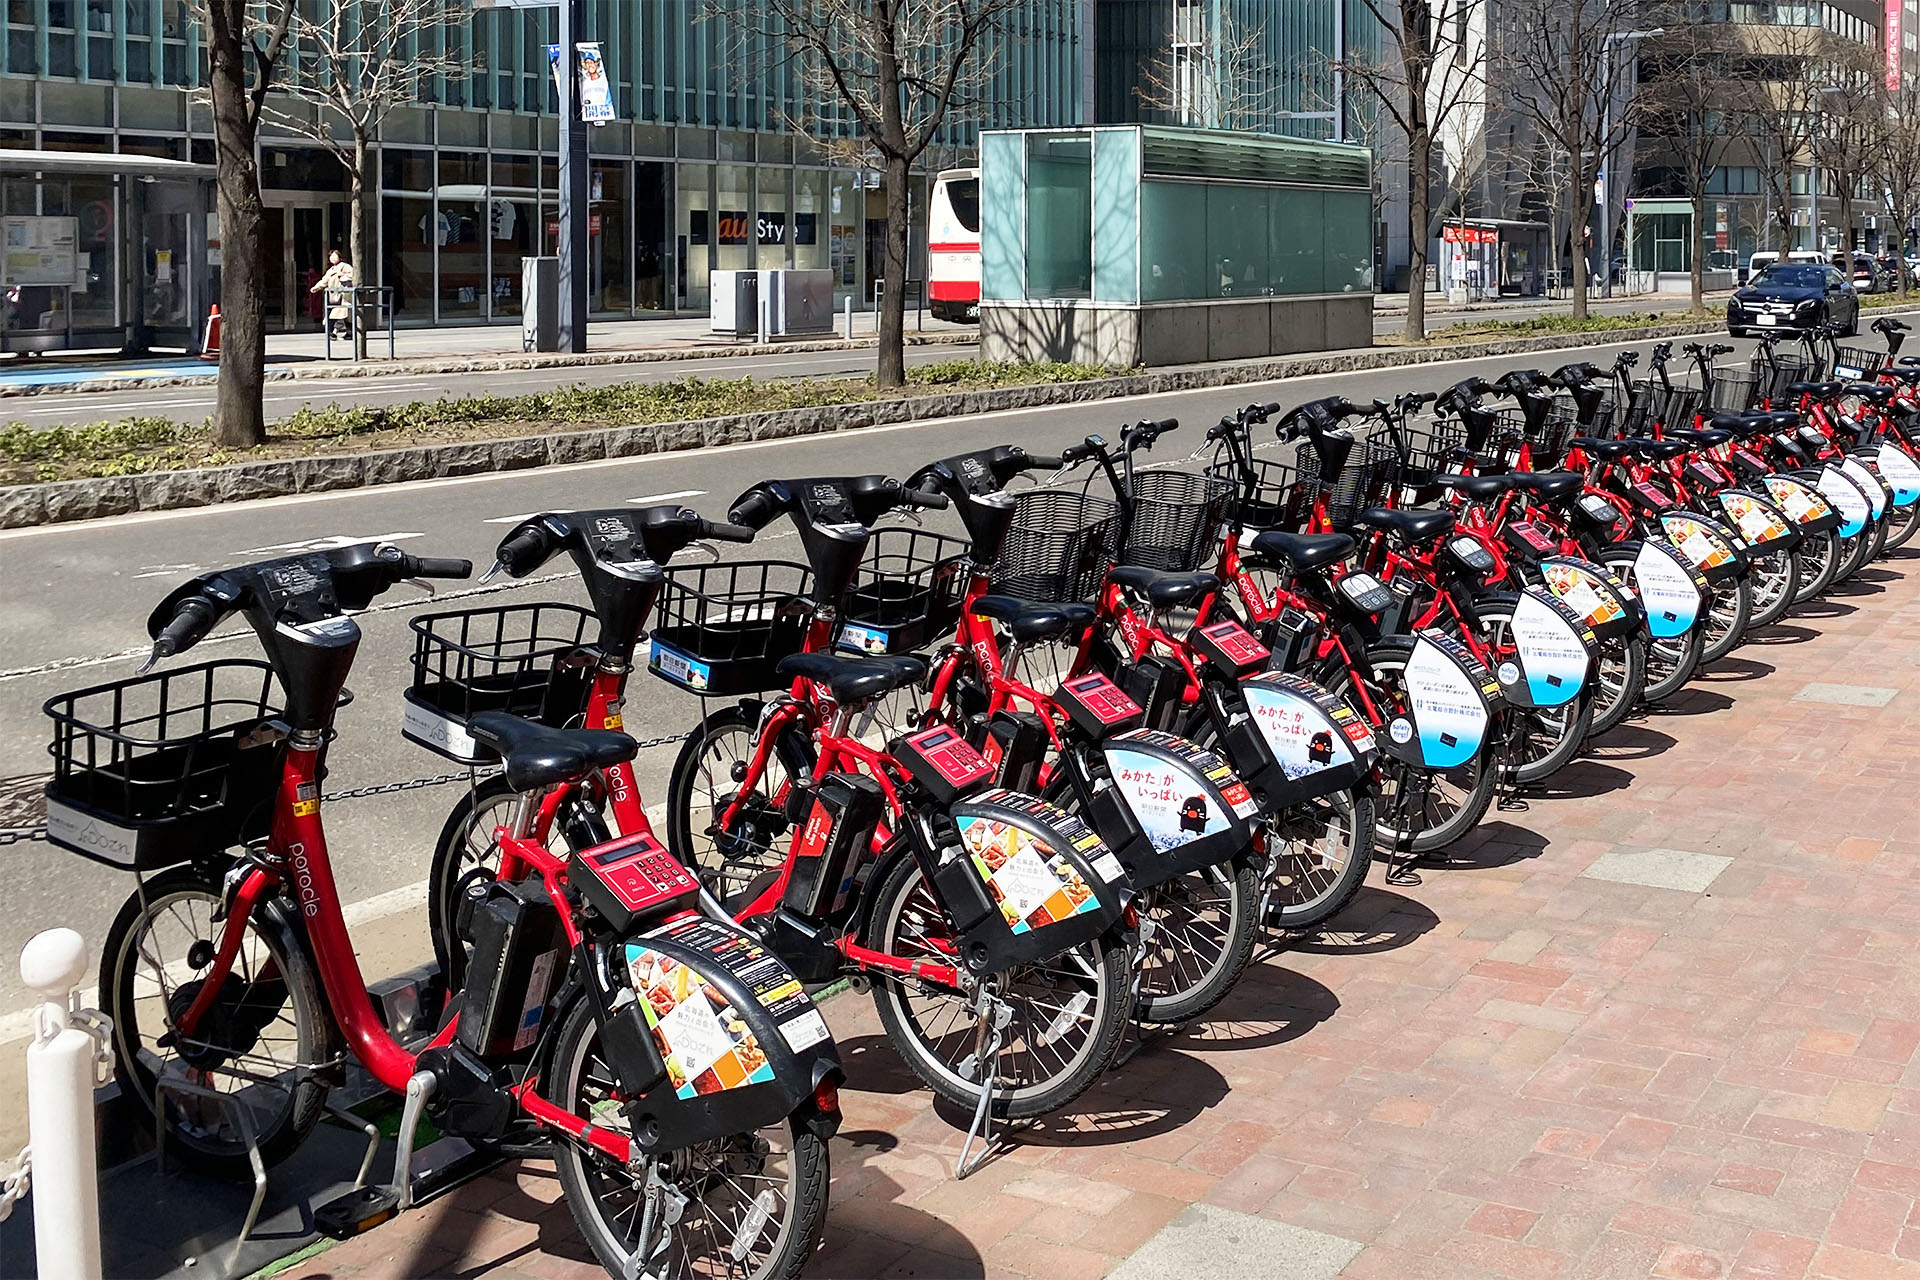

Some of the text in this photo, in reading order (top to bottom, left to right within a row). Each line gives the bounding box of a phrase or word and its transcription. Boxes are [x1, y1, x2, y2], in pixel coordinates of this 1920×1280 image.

[719, 218, 799, 242] au Stye
[1272, 722, 1312, 736] いっぱい
[609, 764, 628, 802] ocle
[1116, 766, 1175, 786] 「みかた」が
[1138, 788, 1183, 802] いっぱい
[288, 842, 321, 918] porocle
